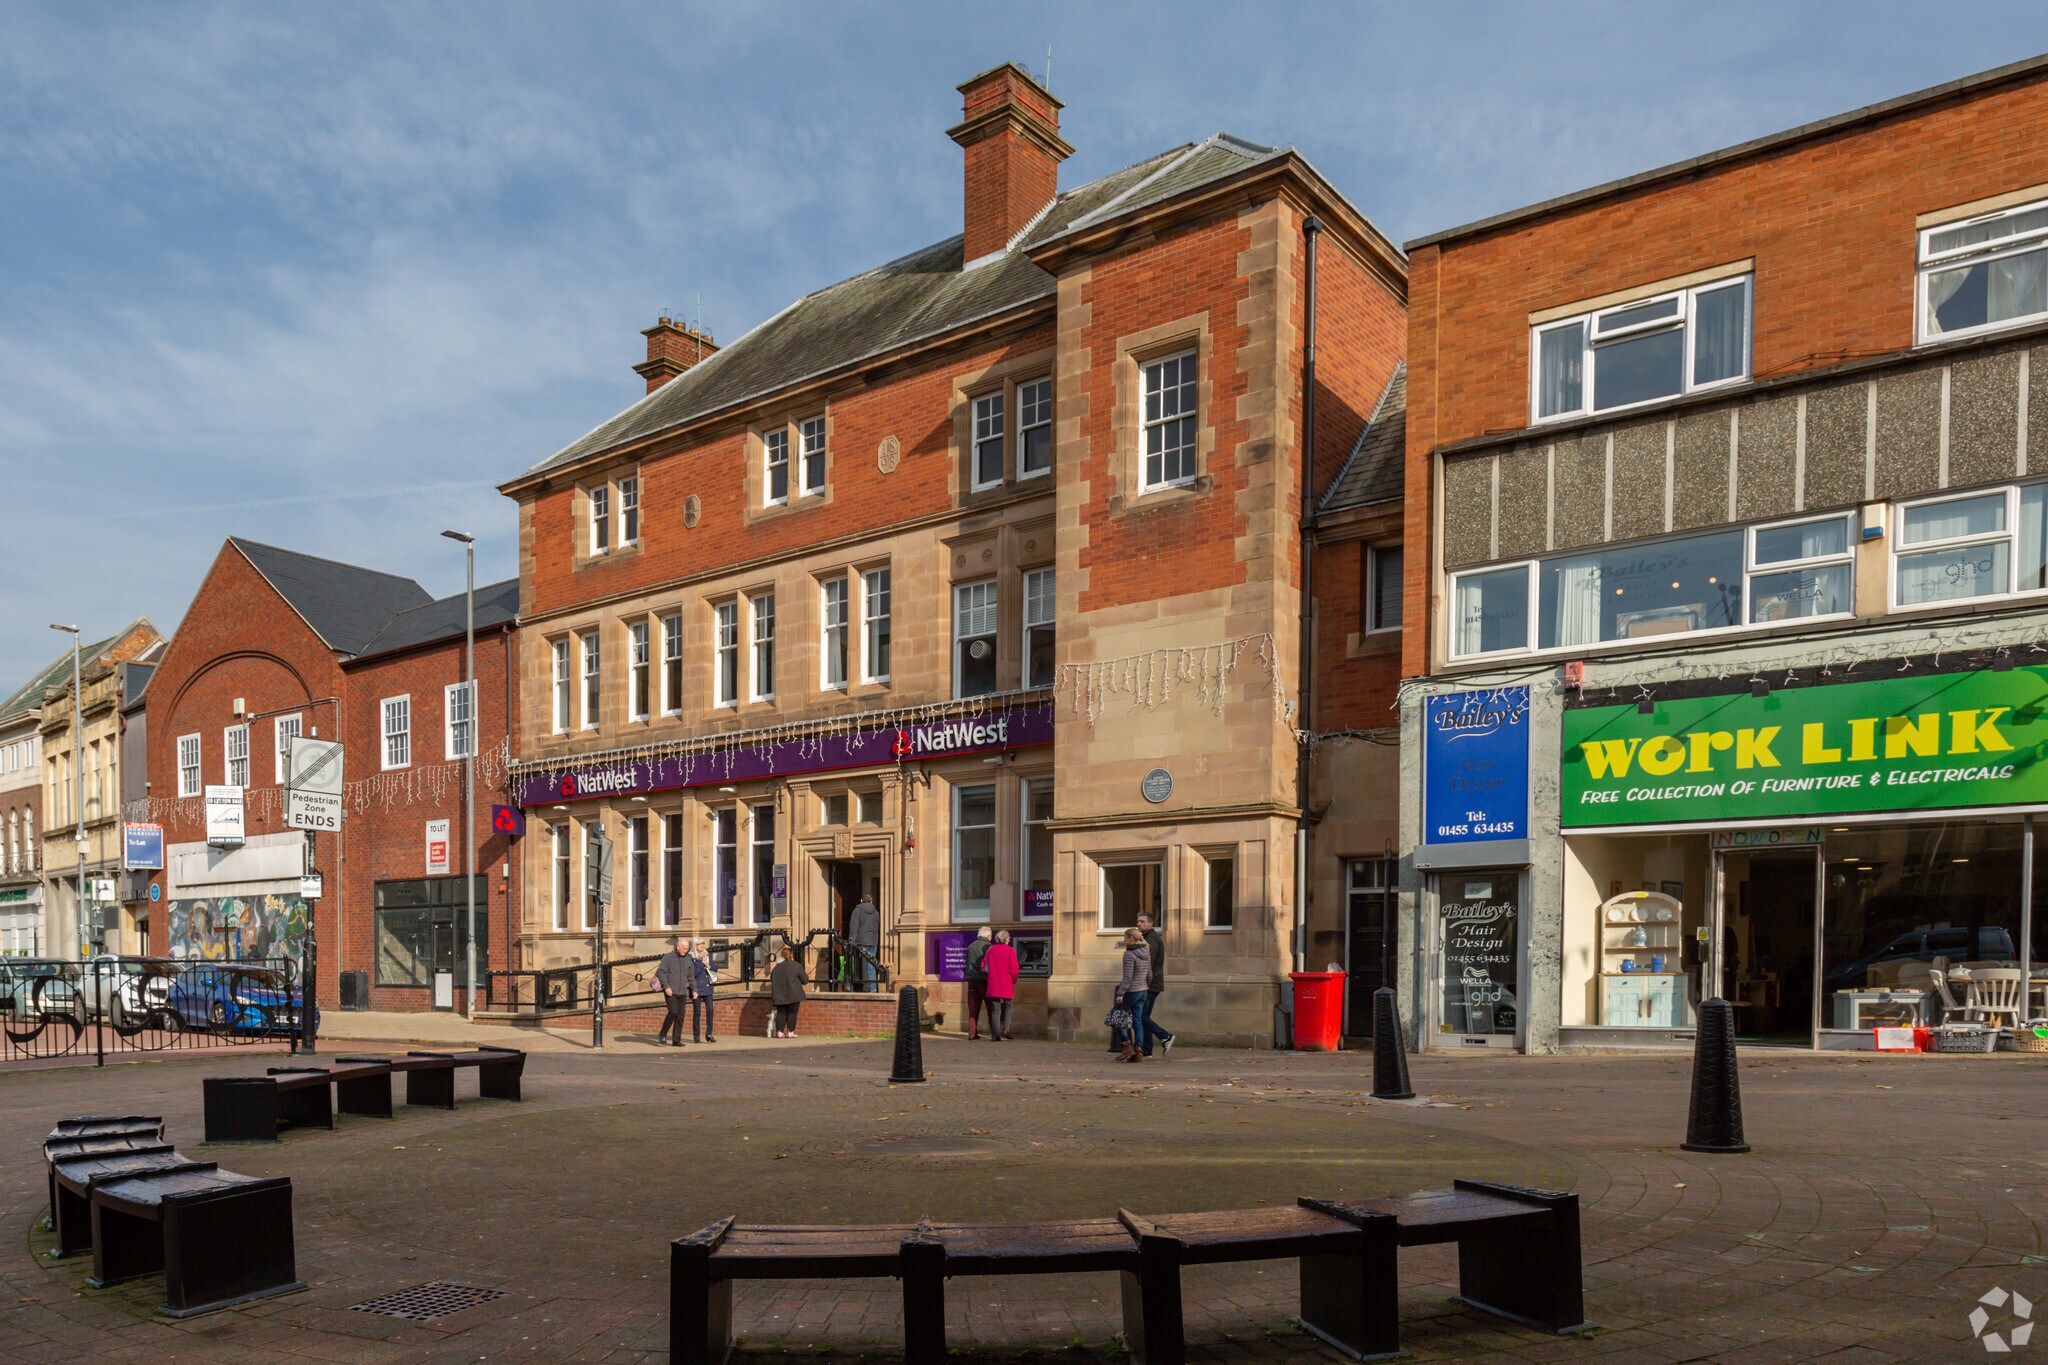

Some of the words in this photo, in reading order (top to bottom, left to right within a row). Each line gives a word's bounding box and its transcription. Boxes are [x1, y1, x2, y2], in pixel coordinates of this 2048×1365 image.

[1588, 558, 1690, 583] Bailey's
[1945, 552, 1993, 585] ghd
[1776, 589, 1824, 602] WELLA
[1434, 702, 1523, 738] Bailey's
[917, 717, 1008, 753] NatWest
[1801, 706, 2015, 765] LINK
[1456, 755, 1498, 773] Hair
[577, 767, 638, 795] NatWest
[1447, 776, 1507, 799] Design
[1580, 789, 1620, 805] FREE
[1626, 782, 1724, 802] COLLECTION
[1730, 780, 1757, 795] OF
[1761, 773, 1862, 795] FURNITURE
[1869, 770, 1880, 786] &
[1886, 764, 2015, 786] ELECTRICALS
[292, 793, 339, 806] Pedestrian
[304, 803, 326, 813] Zone
[295, 813, 335, 828] ENDS
[1466, 811, 1486, 822] Tel:
[437, 824, 446, 832] LET
[1438, 825, 1469, 836] 01455
[1474, 822, 1514, 834] 634435
[1716, 831, 1764, 846] NOW
[1769, 828, 1821, 844] OPEN
[1441, 900, 1518, 925] Bailey's
[1458, 925, 1497, 936] Hair
[1451, 937, 1503, 951] Design
[1447, 955, 1476, 964] 01455
[1476, 953, 1510, 964] 634435
[1459, 977, 1492, 985] WELLA
[1471, 987, 1502, 1007] ghd
